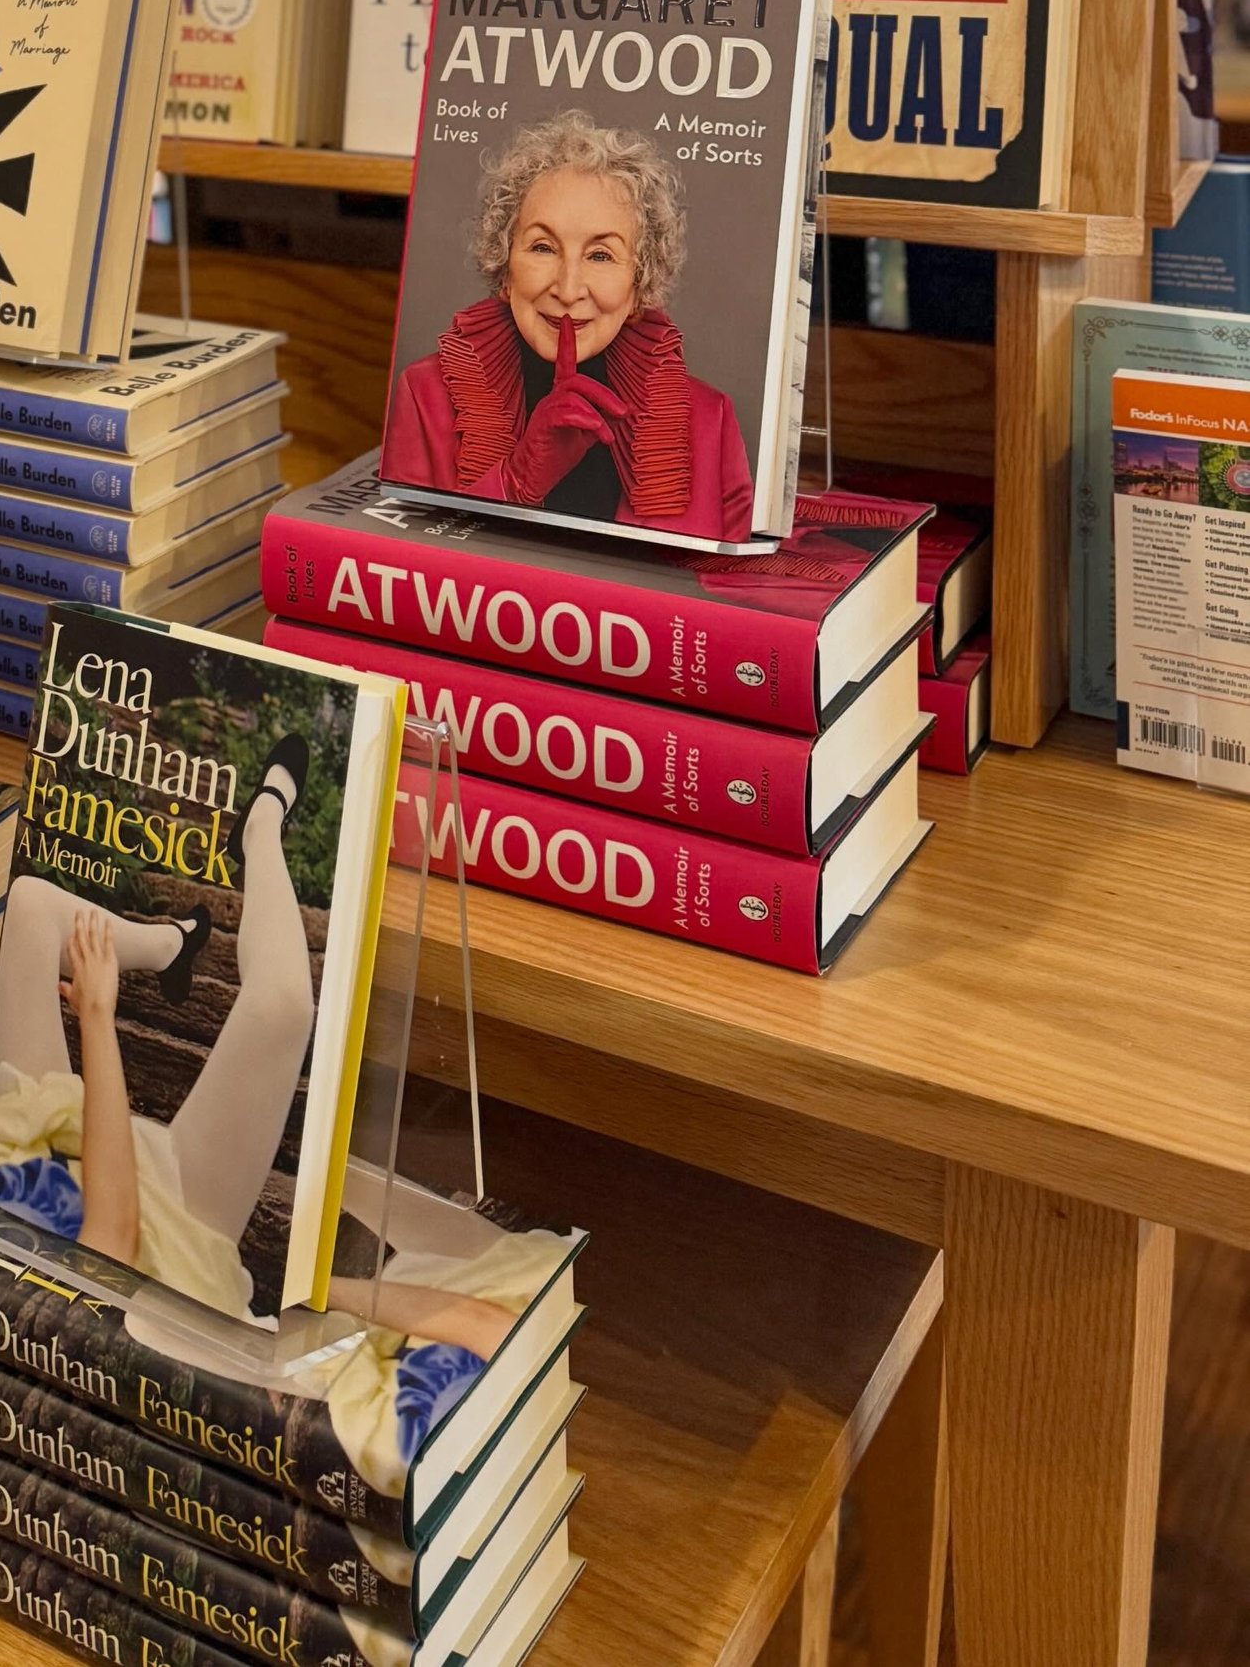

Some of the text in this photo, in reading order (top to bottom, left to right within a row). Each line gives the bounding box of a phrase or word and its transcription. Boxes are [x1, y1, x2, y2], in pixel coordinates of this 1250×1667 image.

[34, 14, 50, 39] of
[181, 26, 235, 44] ROCK
[9, 38, 71, 65] Marriage
[439, 25, 773, 99] ATWOOD
[437, 98, 509, 120] Book of
[654, 113, 767, 139] A Memoir
[433, 124, 479, 144] Lives
[676, 140, 764, 166] of Sorts
[99, 329, 262, 399] Belle Burden
[18, 406, 72, 432] Burden
[1130, 408, 1219, 429] Fodor's InFocus
[22, 461, 76, 490] Burden
[20, 515, 75, 544] Burden
[1133, 505, 1152, 516] Ready
[1163, 510, 1172, 519] Go
[1174, 511, 1196, 523] Away?
[1205, 516, 1245, 529] Get Inspired
[286, 545, 298, 604] Book of
[304, 559, 315, 599] Lives
[1205, 560, 1249, 575] Get Planning
[327, 556, 651, 677] ATWOOD
[1206, 603, 1239, 617] Get Going
[42, 622, 153, 715] Lena
[670, 614, 686, 697] A Memoir
[691, 630, 708, 695] of Sorts
[770, 646, 779, 710] DOUBLEDAY
[32, 689, 238, 815] Dunham
[22, 754, 235, 888] Famesick
[17, 828, 122, 890] A Memoir
[137, 1374, 298, 1490] Famesick
[145, 1465, 309, 1580] Famesick
[140, 1552, 302, 1667] Famesick
